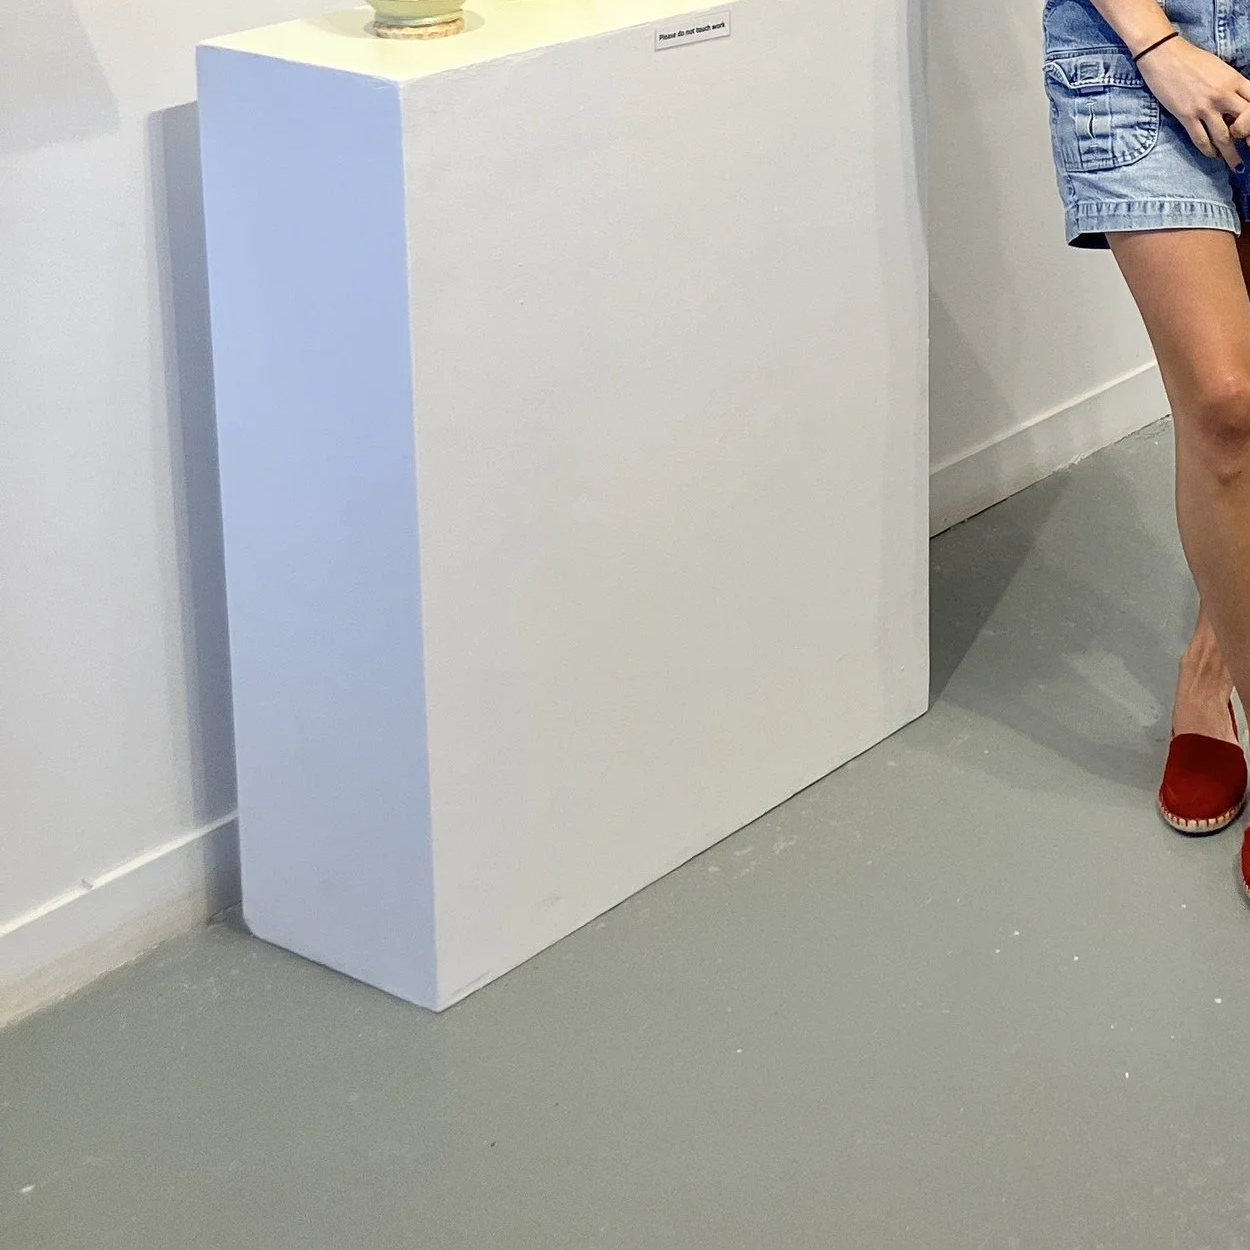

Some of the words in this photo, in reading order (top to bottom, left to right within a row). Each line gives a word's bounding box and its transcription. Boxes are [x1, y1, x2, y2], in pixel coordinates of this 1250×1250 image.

[658, 33, 676, 41] Please
[695, 25, 711, 33] touch
[711, 22, 725, 30] work
